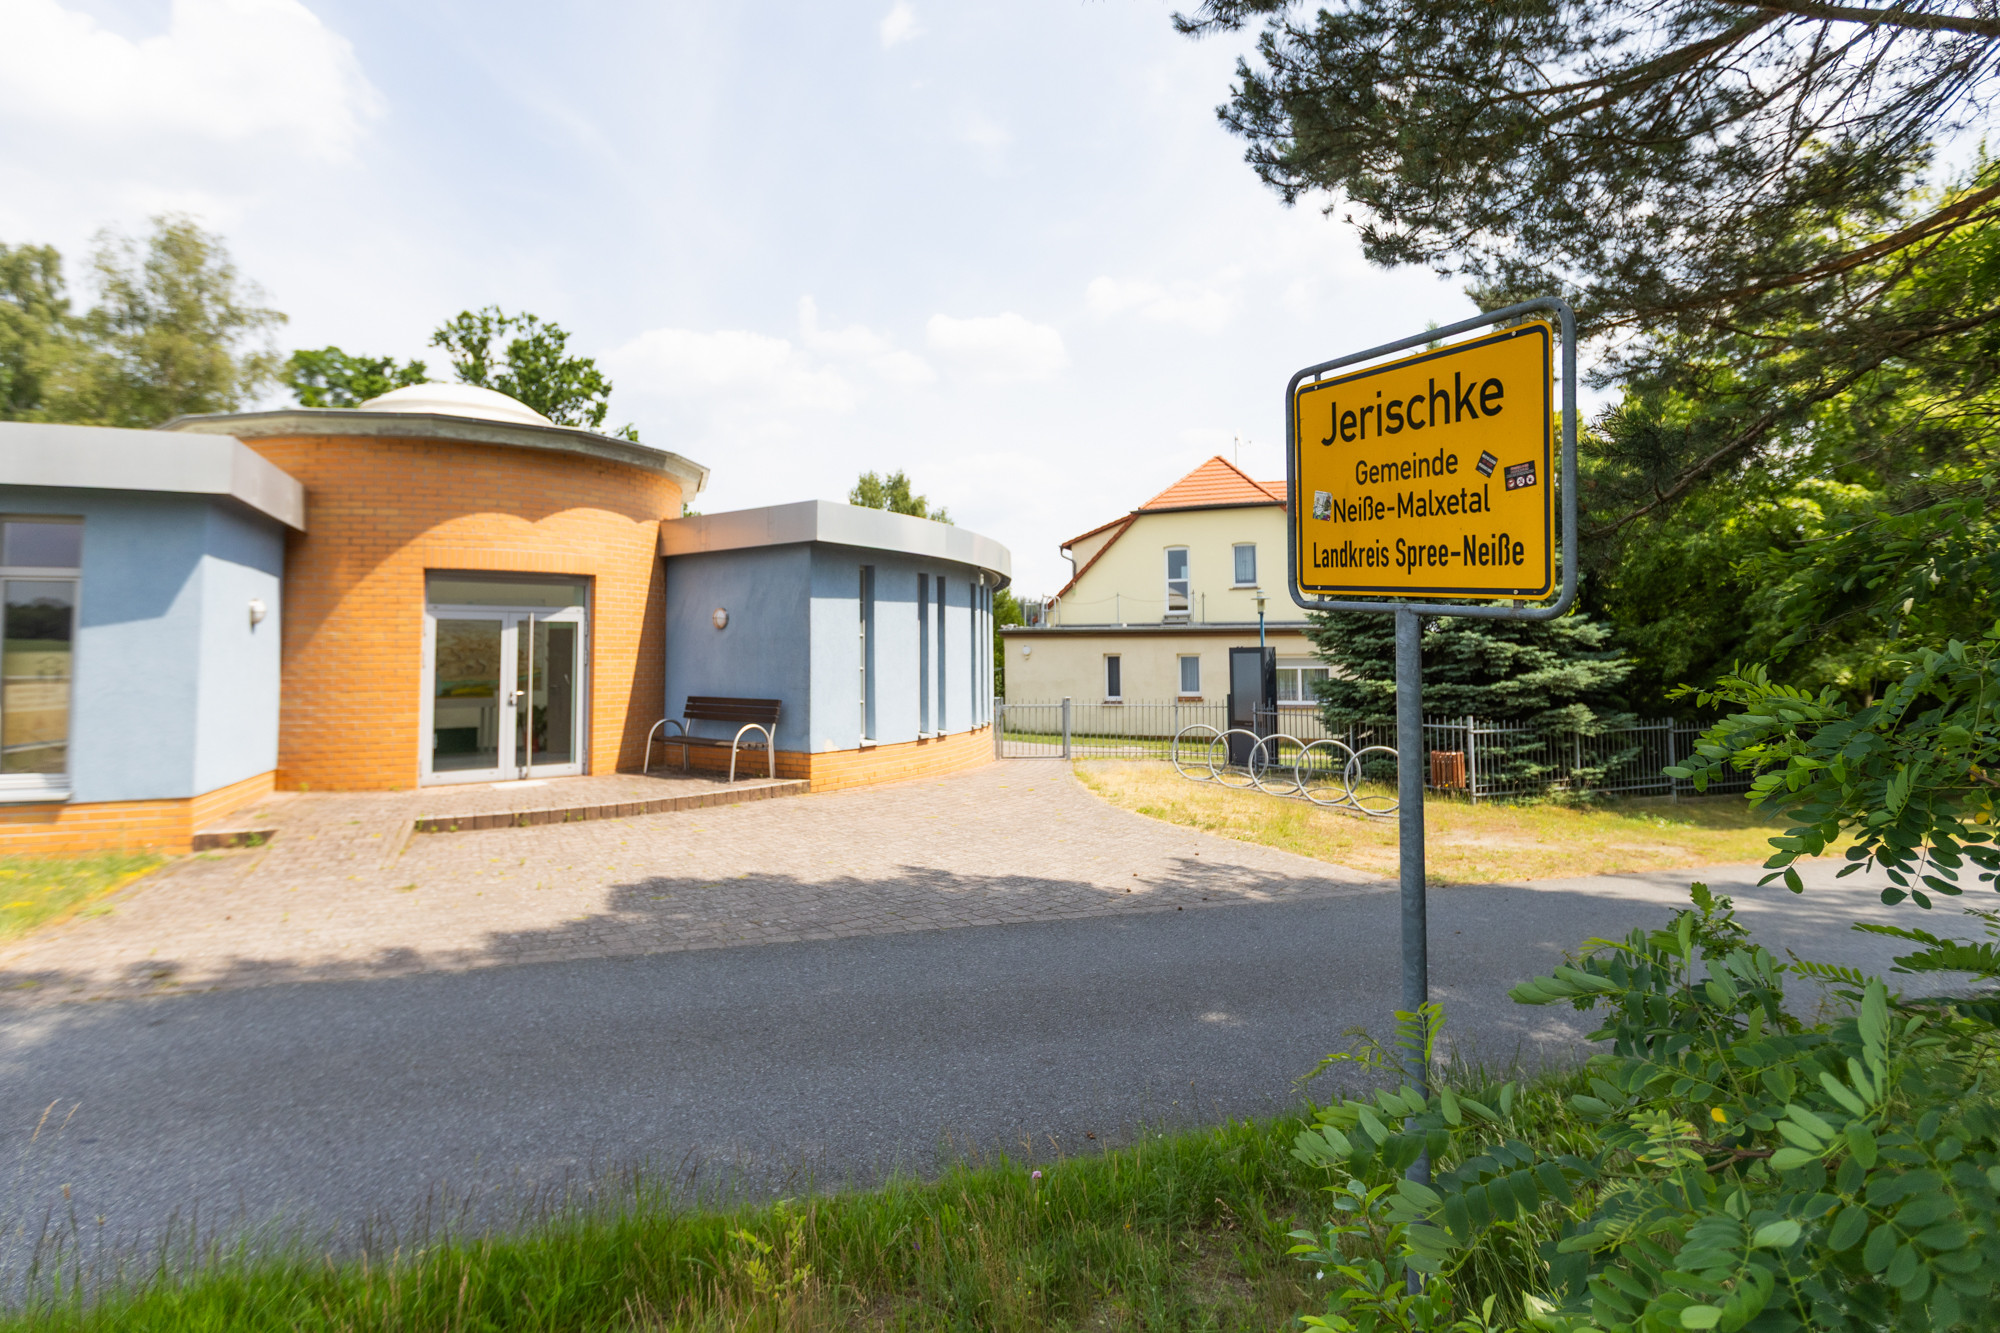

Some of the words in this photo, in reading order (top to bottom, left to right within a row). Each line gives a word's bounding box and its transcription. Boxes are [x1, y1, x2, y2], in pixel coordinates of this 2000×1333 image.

[1321, 371, 1504, 446] Jerischke
[1355, 448, 1458, 485] Gemeinde
[1333, 484, 1490, 523] Neiße-Malxetal
[1313, 539, 1389, 568] Landkreis
[1395, 533, 1524, 575] Spree-Neiße
